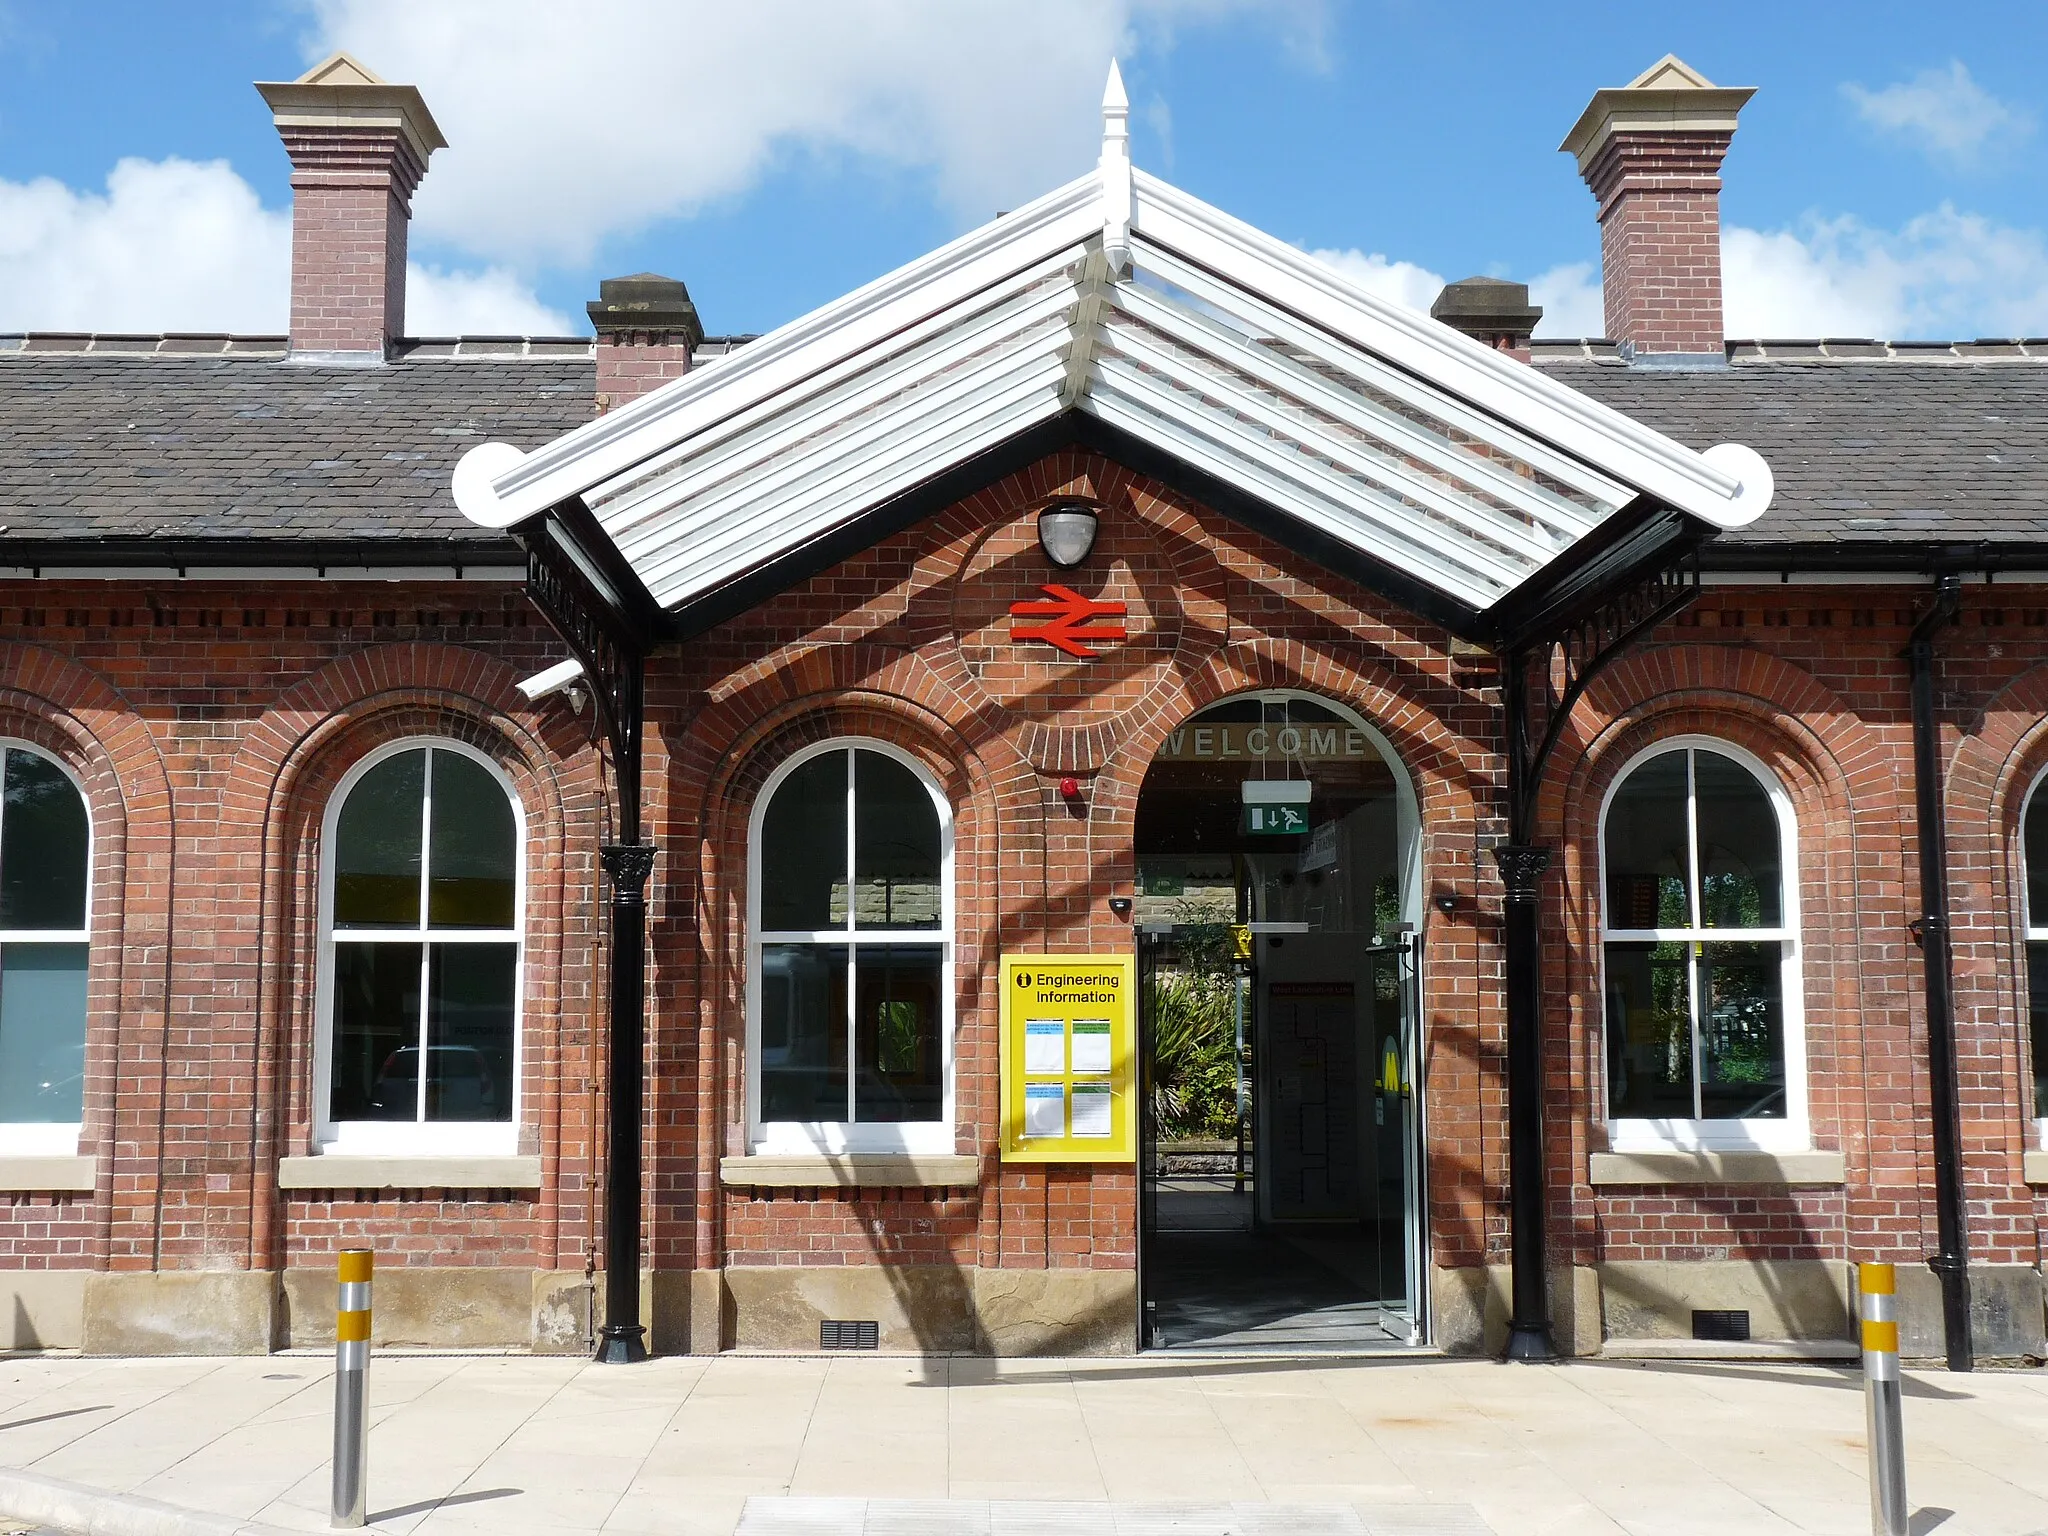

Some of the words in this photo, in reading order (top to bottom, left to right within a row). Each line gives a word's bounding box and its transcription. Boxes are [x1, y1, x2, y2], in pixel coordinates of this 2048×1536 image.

[1157, 728, 1366, 756] WELCOME
[1036, 973, 1119, 988] Engineering
[1036, 990, 1116, 1003] Information
